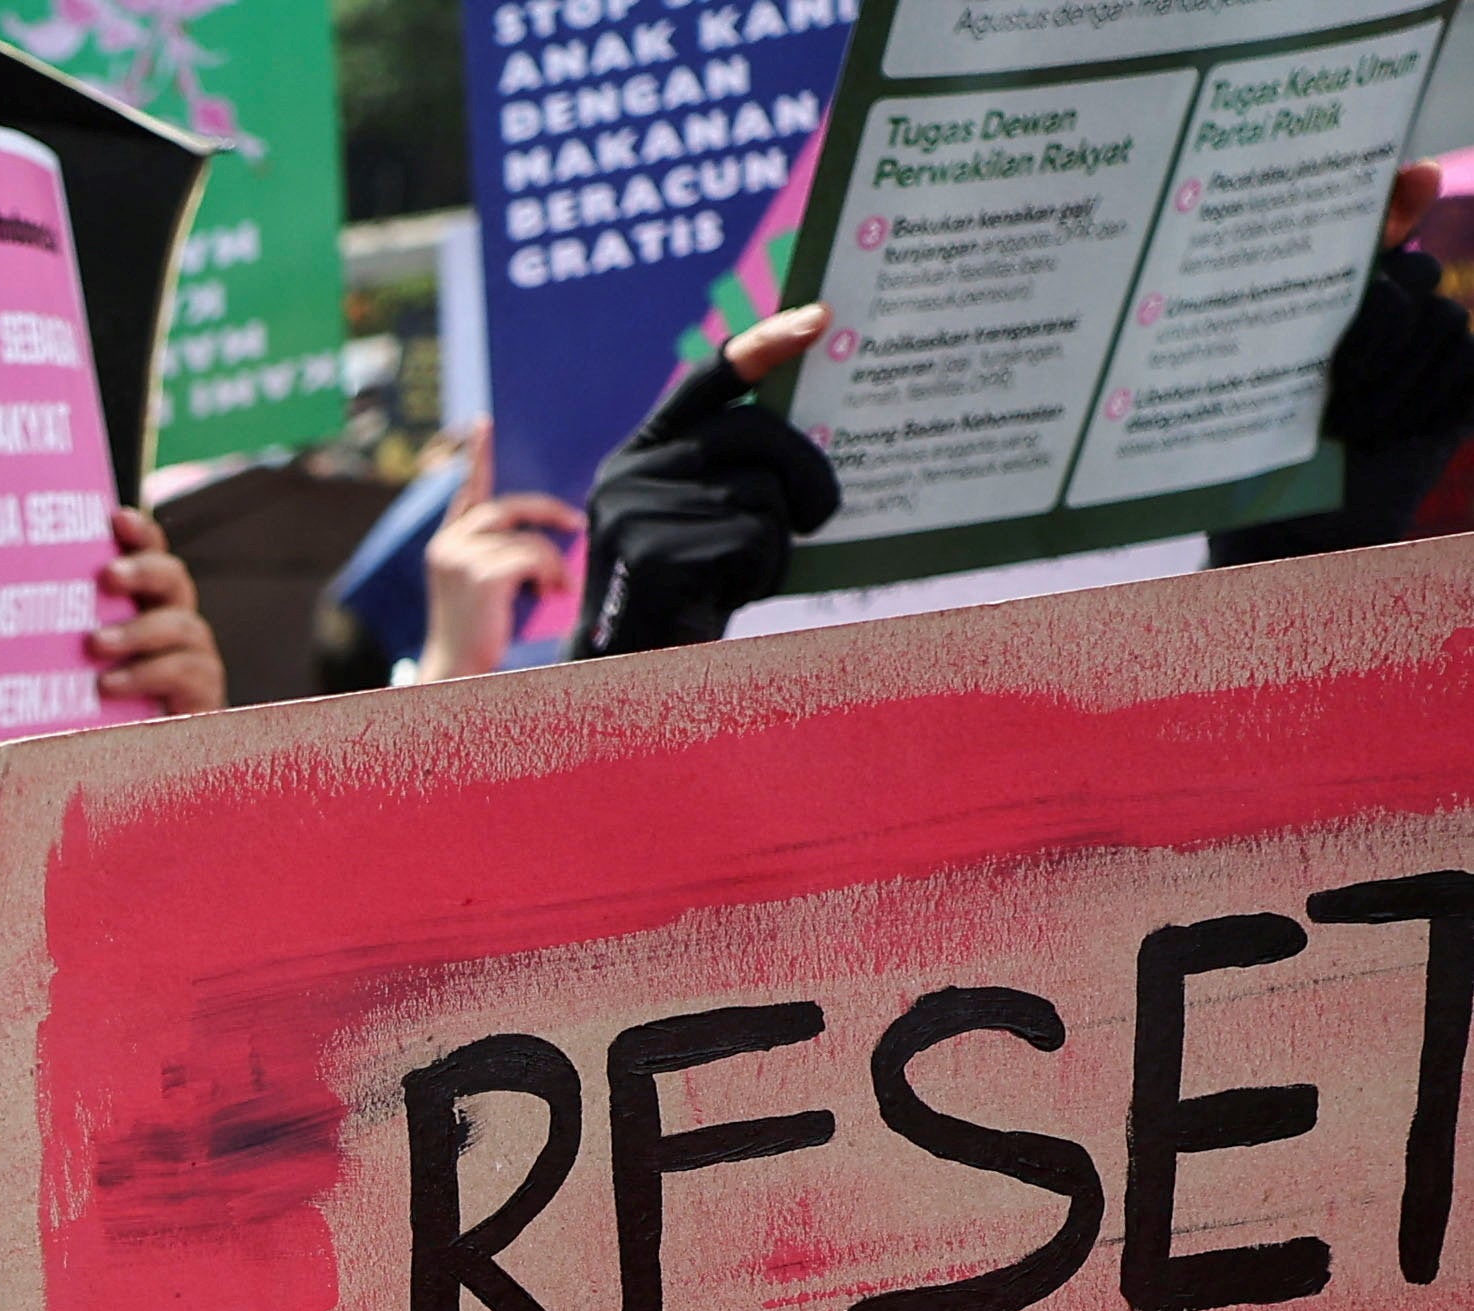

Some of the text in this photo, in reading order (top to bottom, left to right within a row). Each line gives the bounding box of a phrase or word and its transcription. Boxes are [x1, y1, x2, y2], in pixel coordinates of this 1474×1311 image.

[498, 18, 678, 96] ANAK
[498, 55, 751, 145] DENGAN
[502, 89, 821, 193] MAKANAN
[887, 108, 1078, 154] Tugas Dewan
[506, 146, 790, 242] BERACUN
[872, 134, 1135, 189] Perwakilan Rakyat
[507, 208, 726, 290] GRATIS
